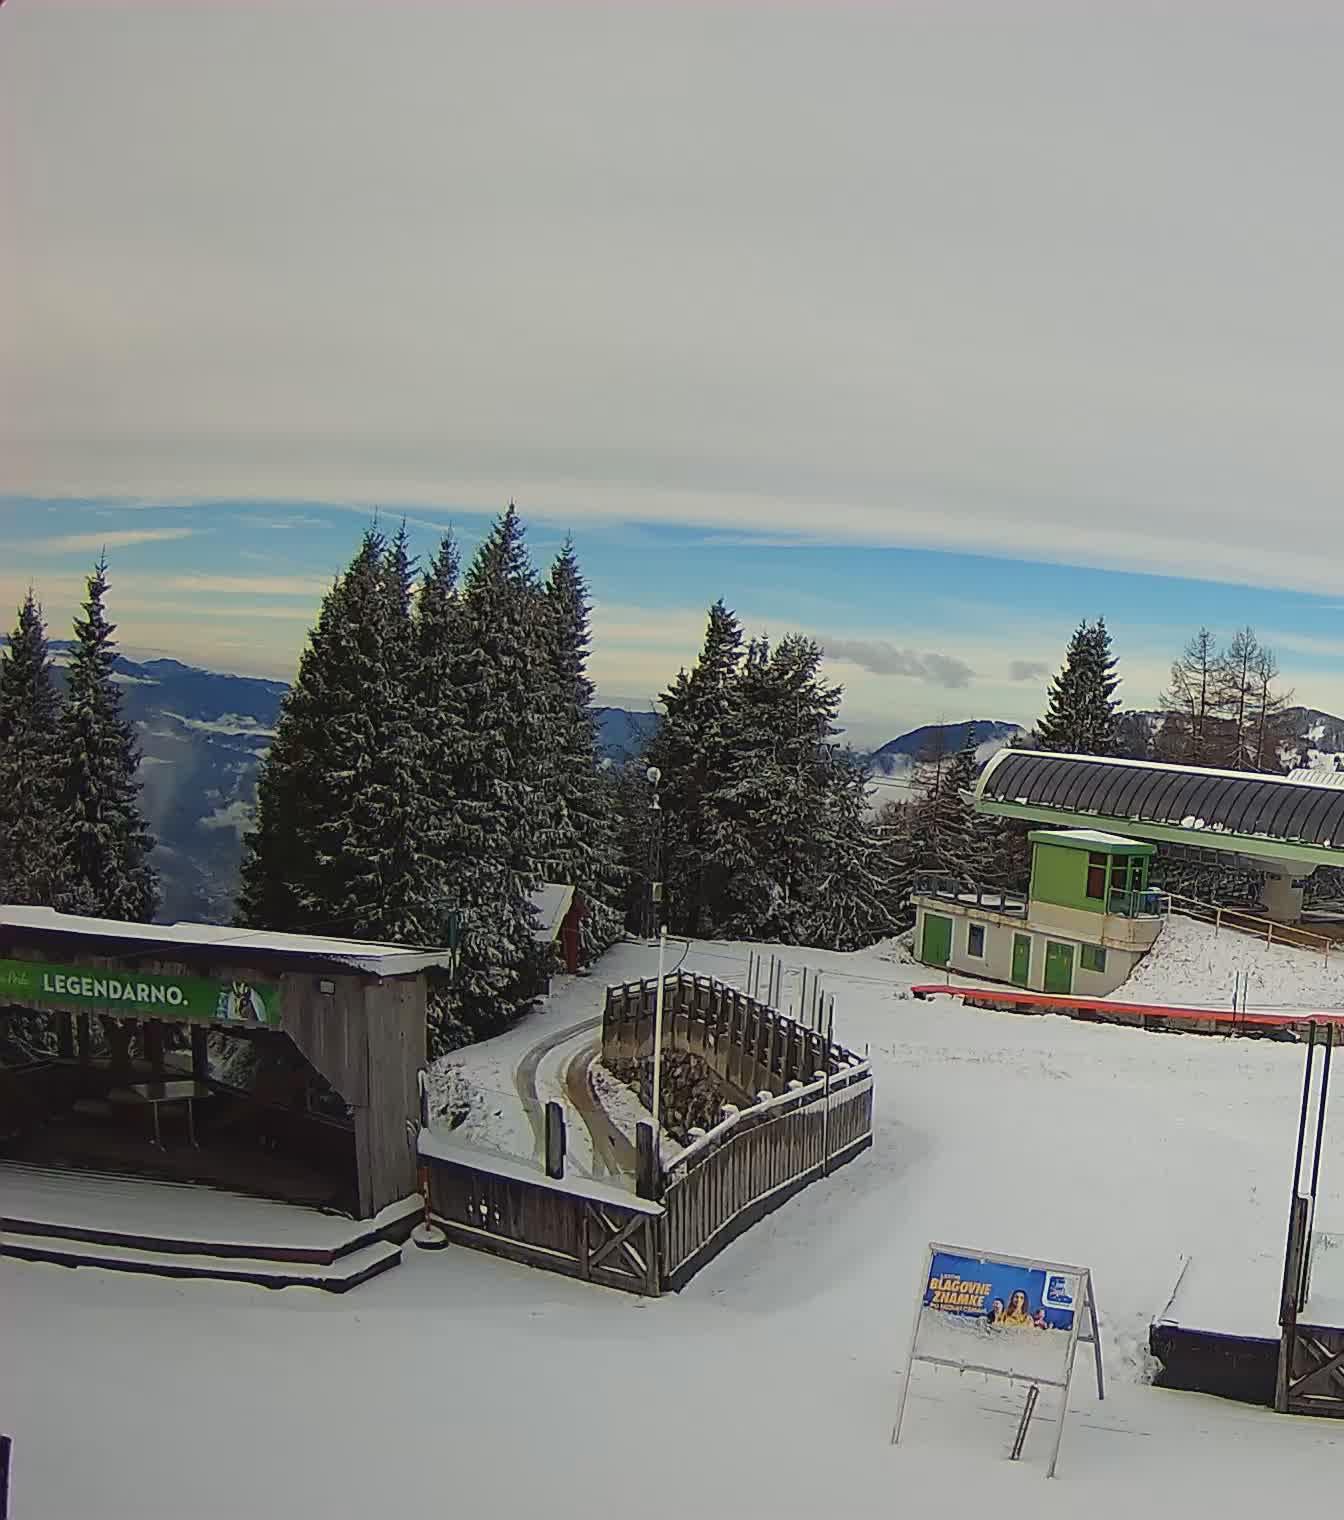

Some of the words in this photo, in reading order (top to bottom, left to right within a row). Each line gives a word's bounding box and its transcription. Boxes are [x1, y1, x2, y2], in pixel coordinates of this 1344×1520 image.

[43, 973, 189, 1006] LEGENDARNO.
[929, 1277, 993, 1296] BLAGOVNE
[932, 1290, 986, 1307] ZNAMKE
